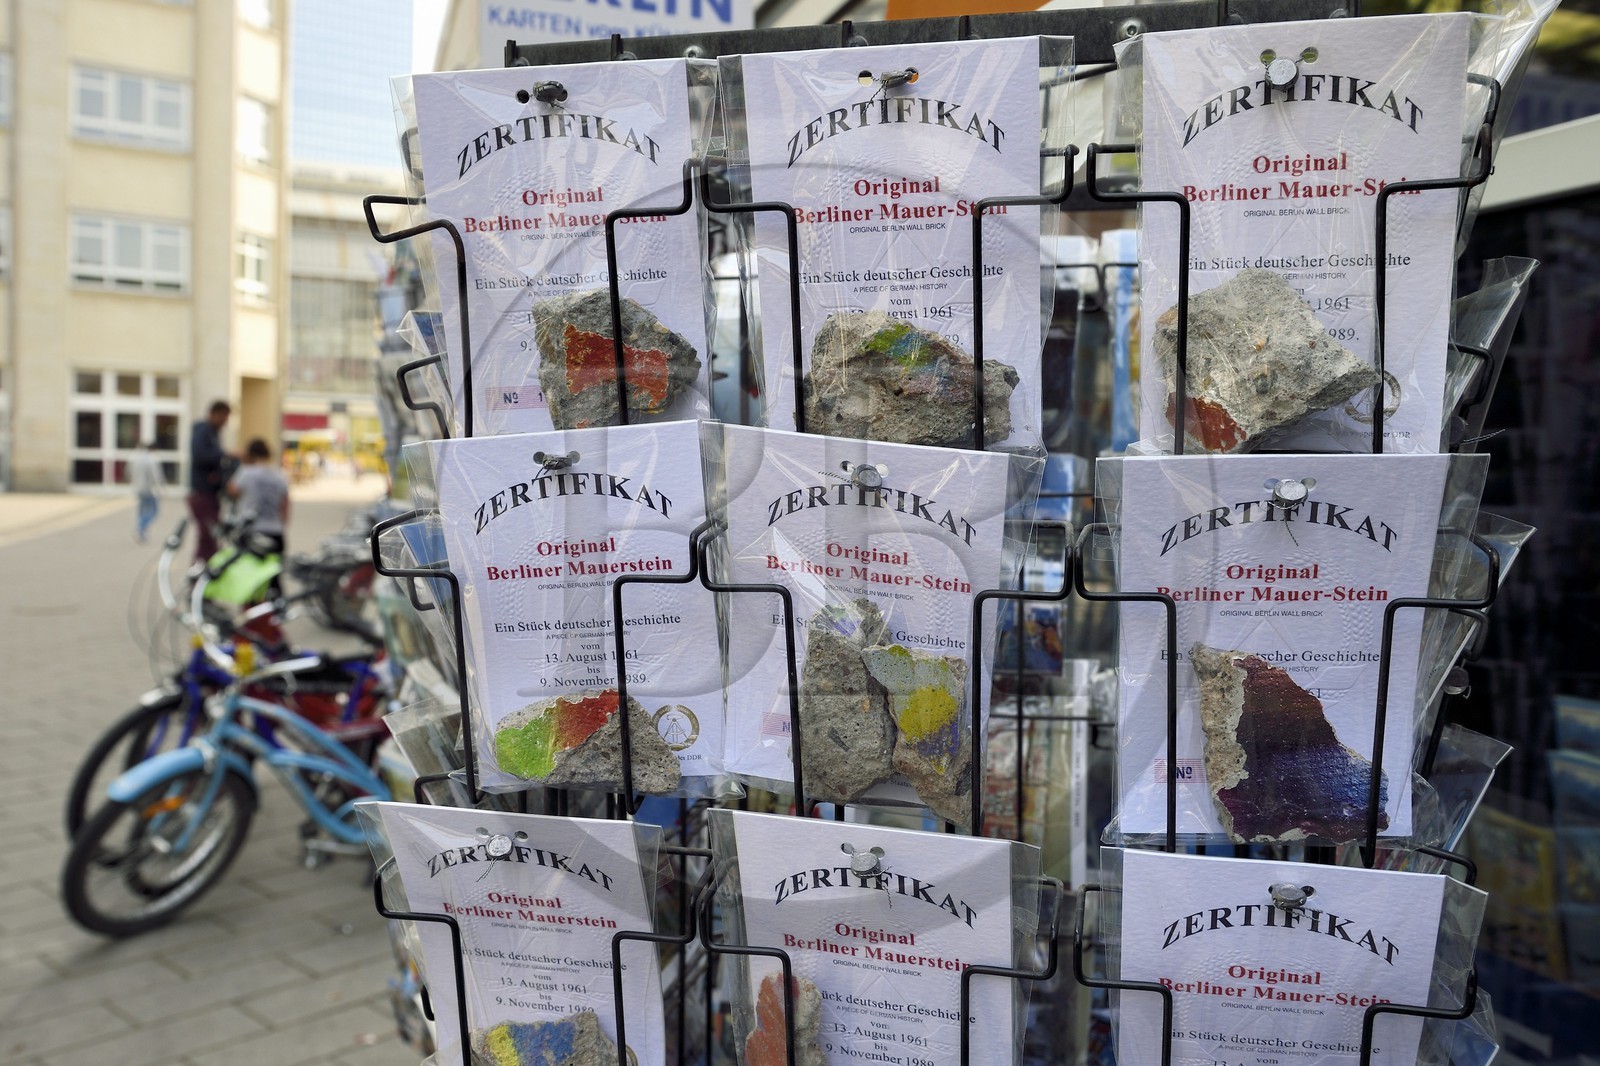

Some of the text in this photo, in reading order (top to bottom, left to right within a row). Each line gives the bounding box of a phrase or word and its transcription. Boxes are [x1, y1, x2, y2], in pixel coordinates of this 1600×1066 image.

[488, 6, 581, 37] KARTEN
[787, 97, 1005, 169] ZERTIFIKAT
[457, 113, 660, 180] ZERTIFIKAT
[1253, 152, 1347, 176] Original
[854, 176, 940, 199] Original
[1182, 177, 1421, 202] Berliner Mauer-St
[522, 187, 604, 208] Original
[464, 208, 668, 233] Berliner Mauertein
[793, 205, 874, 223] Berliner
[1278, 208, 1305, 216] BERLIN
[1327, 207, 1350, 215] BRICK
[521, 233, 549, 241] ORIGINAL
[849, 222, 946, 234] ORIGINAL BERLIN WALL BRICK
[1187, 254, 1411, 270] Ein Stück deutscher Geschhte
[475, 268, 668, 291] Ein Stück deutscher Gschichte
[800, 264, 1004, 284] Ein Stück deutscher Geschihte
[919, 282, 948, 290] HISTORY
[890, 298, 912, 306] vom
[923, 305, 953, 318] 1961
[1317, 297, 1349, 310] 1961
[1329, 328, 1359, 340] 989.
[521, 341, 532, 352] 9.
[474, 472, 673, 535] ZERTIFIKAT
[768, 483, 976, 547] ZERTIFIKAT
[1159, 500, 1398, 557] ZERTIFIKAT
[537, 538, 615, 558] Original
[826, 543, 908, 565] Original
[487, 556, 672, 581] Berliner Mauerstein
[766, 554, 971, 593] Berliner Mauer-Stein
[1226, 564, 1319, 583] Original
[538, 582, 566, 590] ORIGINAL
[567, 581, 589, 589] BERLIN
[853, 588, 876, 596] BERLIN
[1156, 585, 1388, 602] Berliner Mauer-Stein
[495, 614, 681, 633] Ein Stück deutscher eschichte
[579, 631, 605, 639] GERMAN
[896, 629, 966, 649] Geschichte
[545, 650, 639, 665] 13. August 161
[1301, 650, 1380, 662] Geschichte
[586, 666, 600, 674] bis
[1289, 665, 1319, 673] HISTORY
[540, 673, 650, 689] 9. November 989.
[427, 844, 613, 892] ZERTFIKAT
[488, 892, 562, 909] Original
[774, 867, 977, 929] ZERTIFIKAT
[443, 901, 617, 929] Berliner Mauerstein
[835, 923, 915, 945] Original
[1162, 904, 1399, 966] ZERTIFIKAT
[475, 947, 627, 970] Stück deutscher Geschice
[783, 934, 972, 972] Berliner Mauerstein
[832, 959, 862, 969] ORIGINAL
[863, 963, 884, 972] BERLIN
[885, 966, 902, 974] WALL
[1228, 965, 1321, 985] Original
[501, 977, 587, 994] 13. August 1961
[1159, 977, 1391, 1007] Berliner Mauer-Stein
[496, 997, 565, 1012] 9. November
[539, 993, 552, 1001] bis
[1221, 1002, 1254, 1010] ORIGINAL
[821, 990, 976, 1024] ück deutscher Geschiche
[869, 1010, 897, 1019] GERMAN
[897, 1015, 923, 1024] HISTORY
[834, 1023, 928, 1047] 13. August 1961
[1189, 1030, 1380, 1054] Stück deutscher Geschice
[826, 1044, 837, 1054] 9.
[840, 1046, 902, 1064] November
[874, 1042, 888, 1051] bis
[1288, 1050, 1319, 1058] HISTORY
[1256, 1057, 1279, 1065] vom
